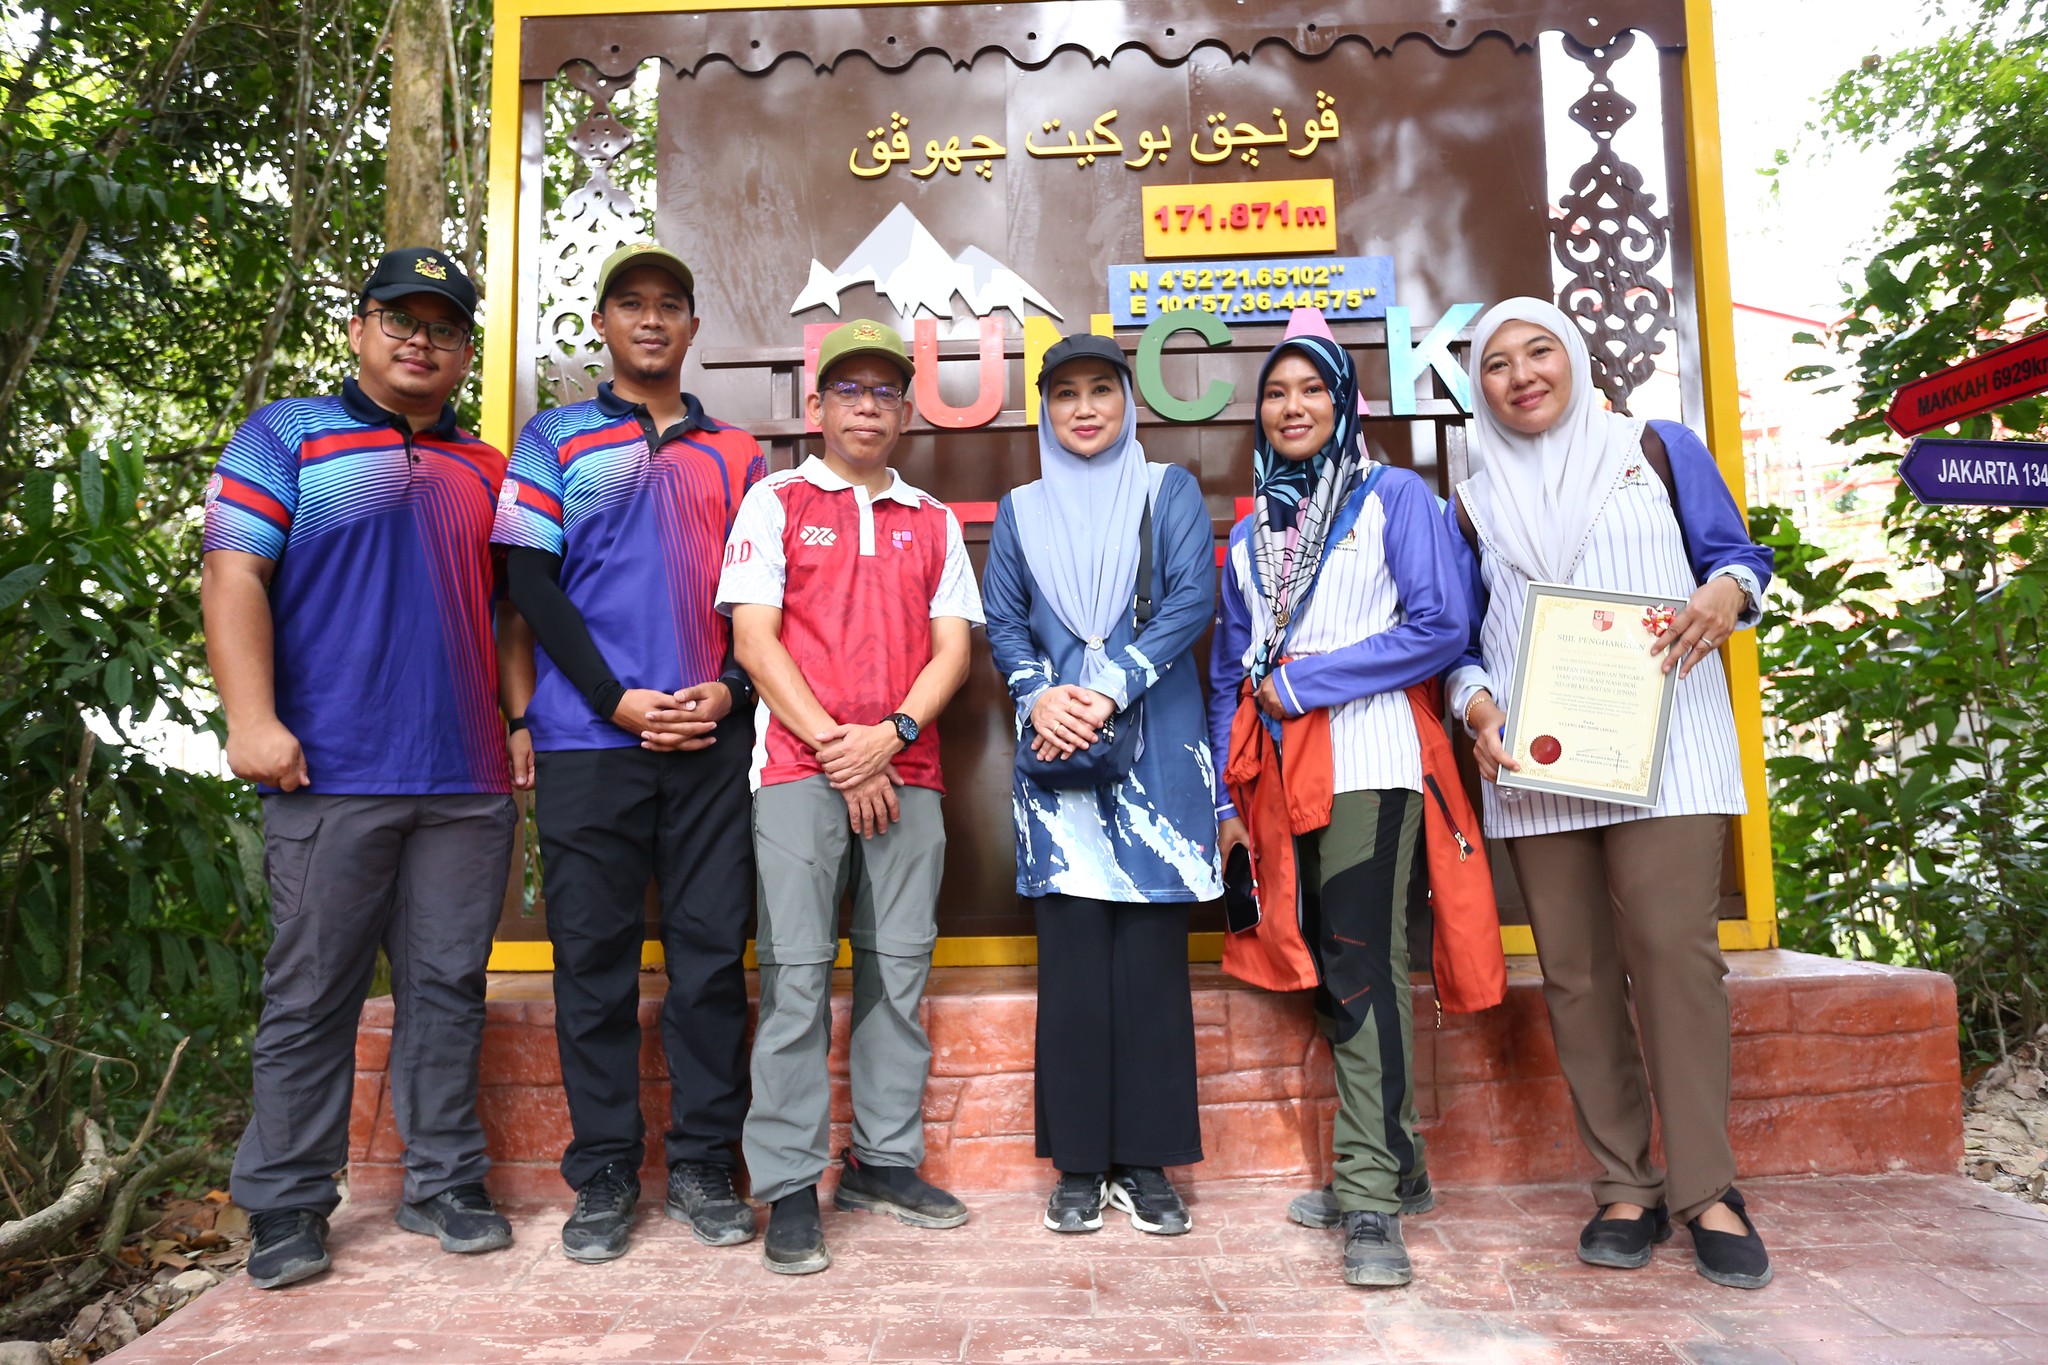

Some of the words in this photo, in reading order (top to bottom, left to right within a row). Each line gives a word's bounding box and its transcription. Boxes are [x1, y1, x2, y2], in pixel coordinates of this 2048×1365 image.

[1154, 200, 1326, 232] 171.871m
[1129, 271, 1149, 291] N
[1130, 296, 1148, 316] E
[1917, 374, 1988, 418] MAKKAH
[1938, 458, 2020, 486] JAKARTA
[1579, 637, 1646, 651] PENGHARGAN
